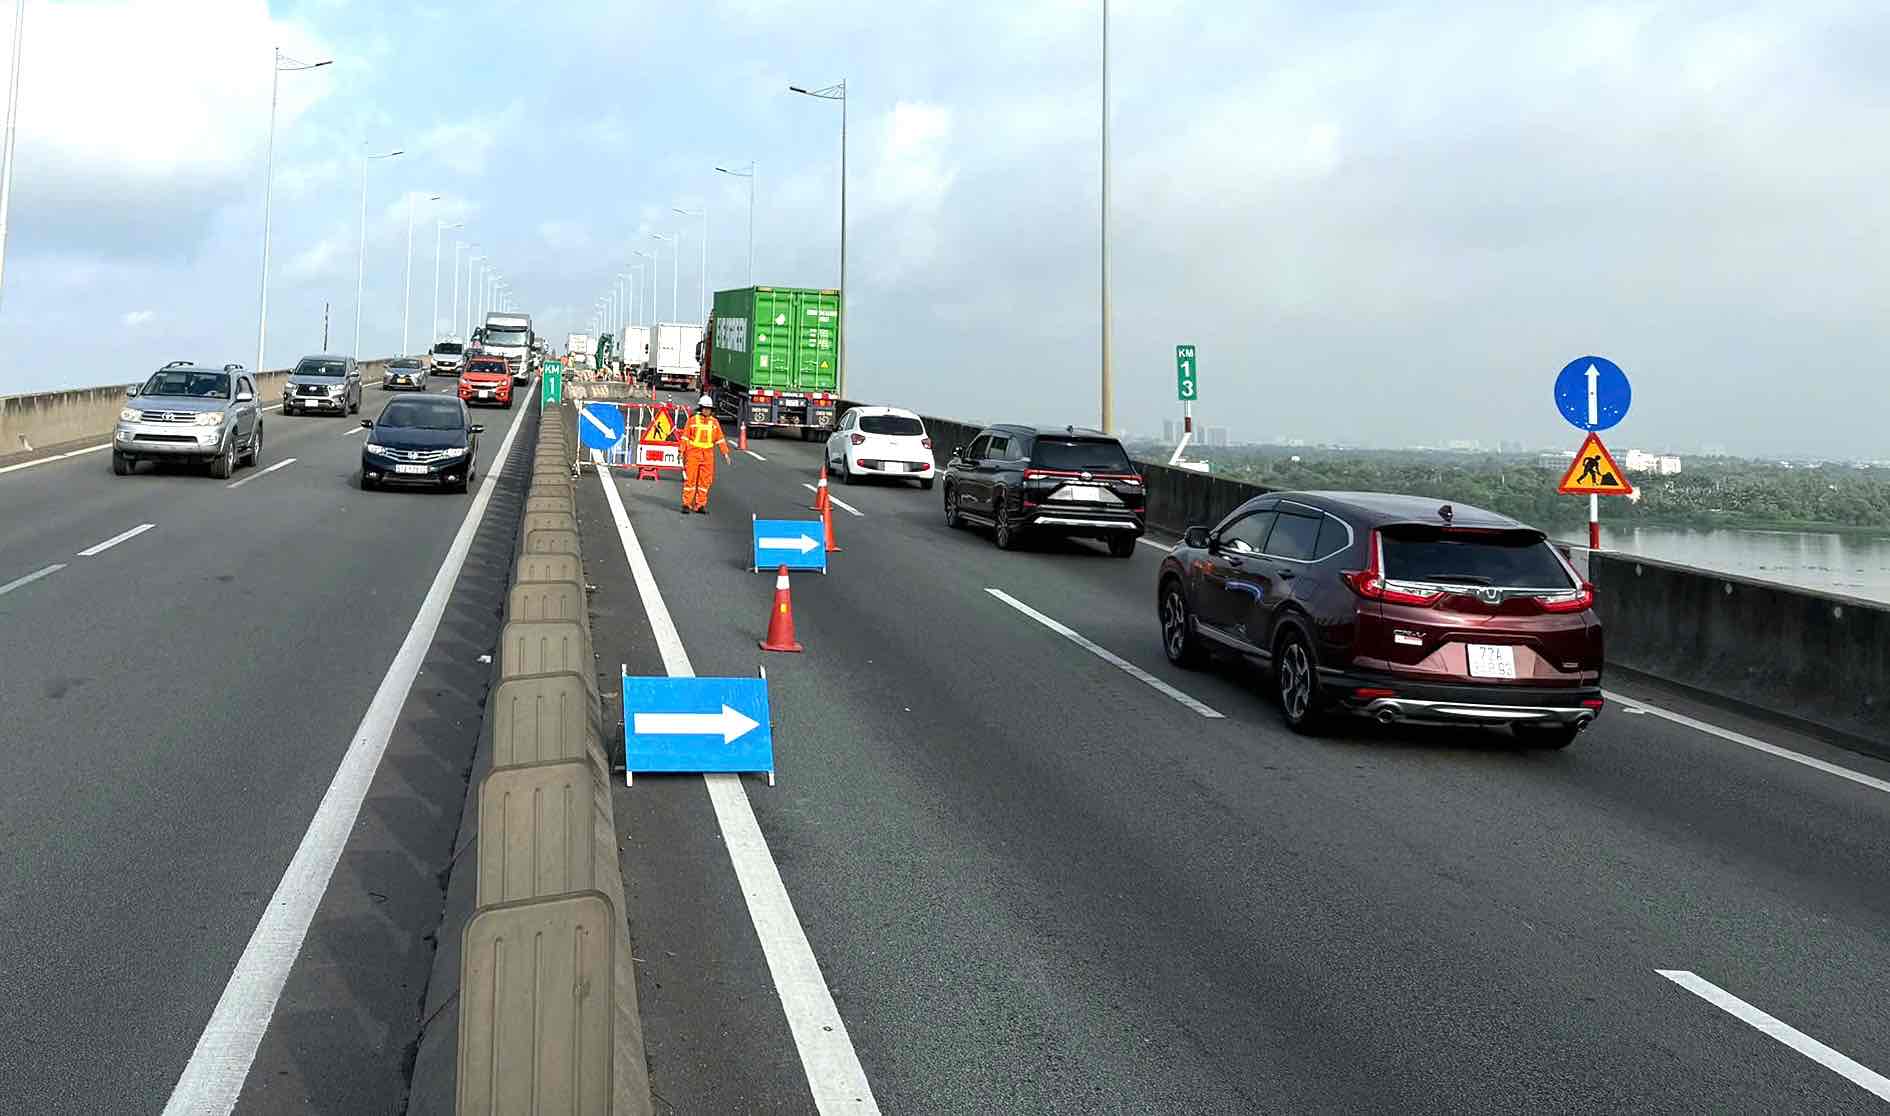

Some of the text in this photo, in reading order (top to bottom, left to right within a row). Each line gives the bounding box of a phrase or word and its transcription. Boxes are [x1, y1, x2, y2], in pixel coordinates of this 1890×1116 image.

[1178, 348, 1194, 358] KM
[544, 364, 560, 375] KM
[549, 376, 555, 395] 1
